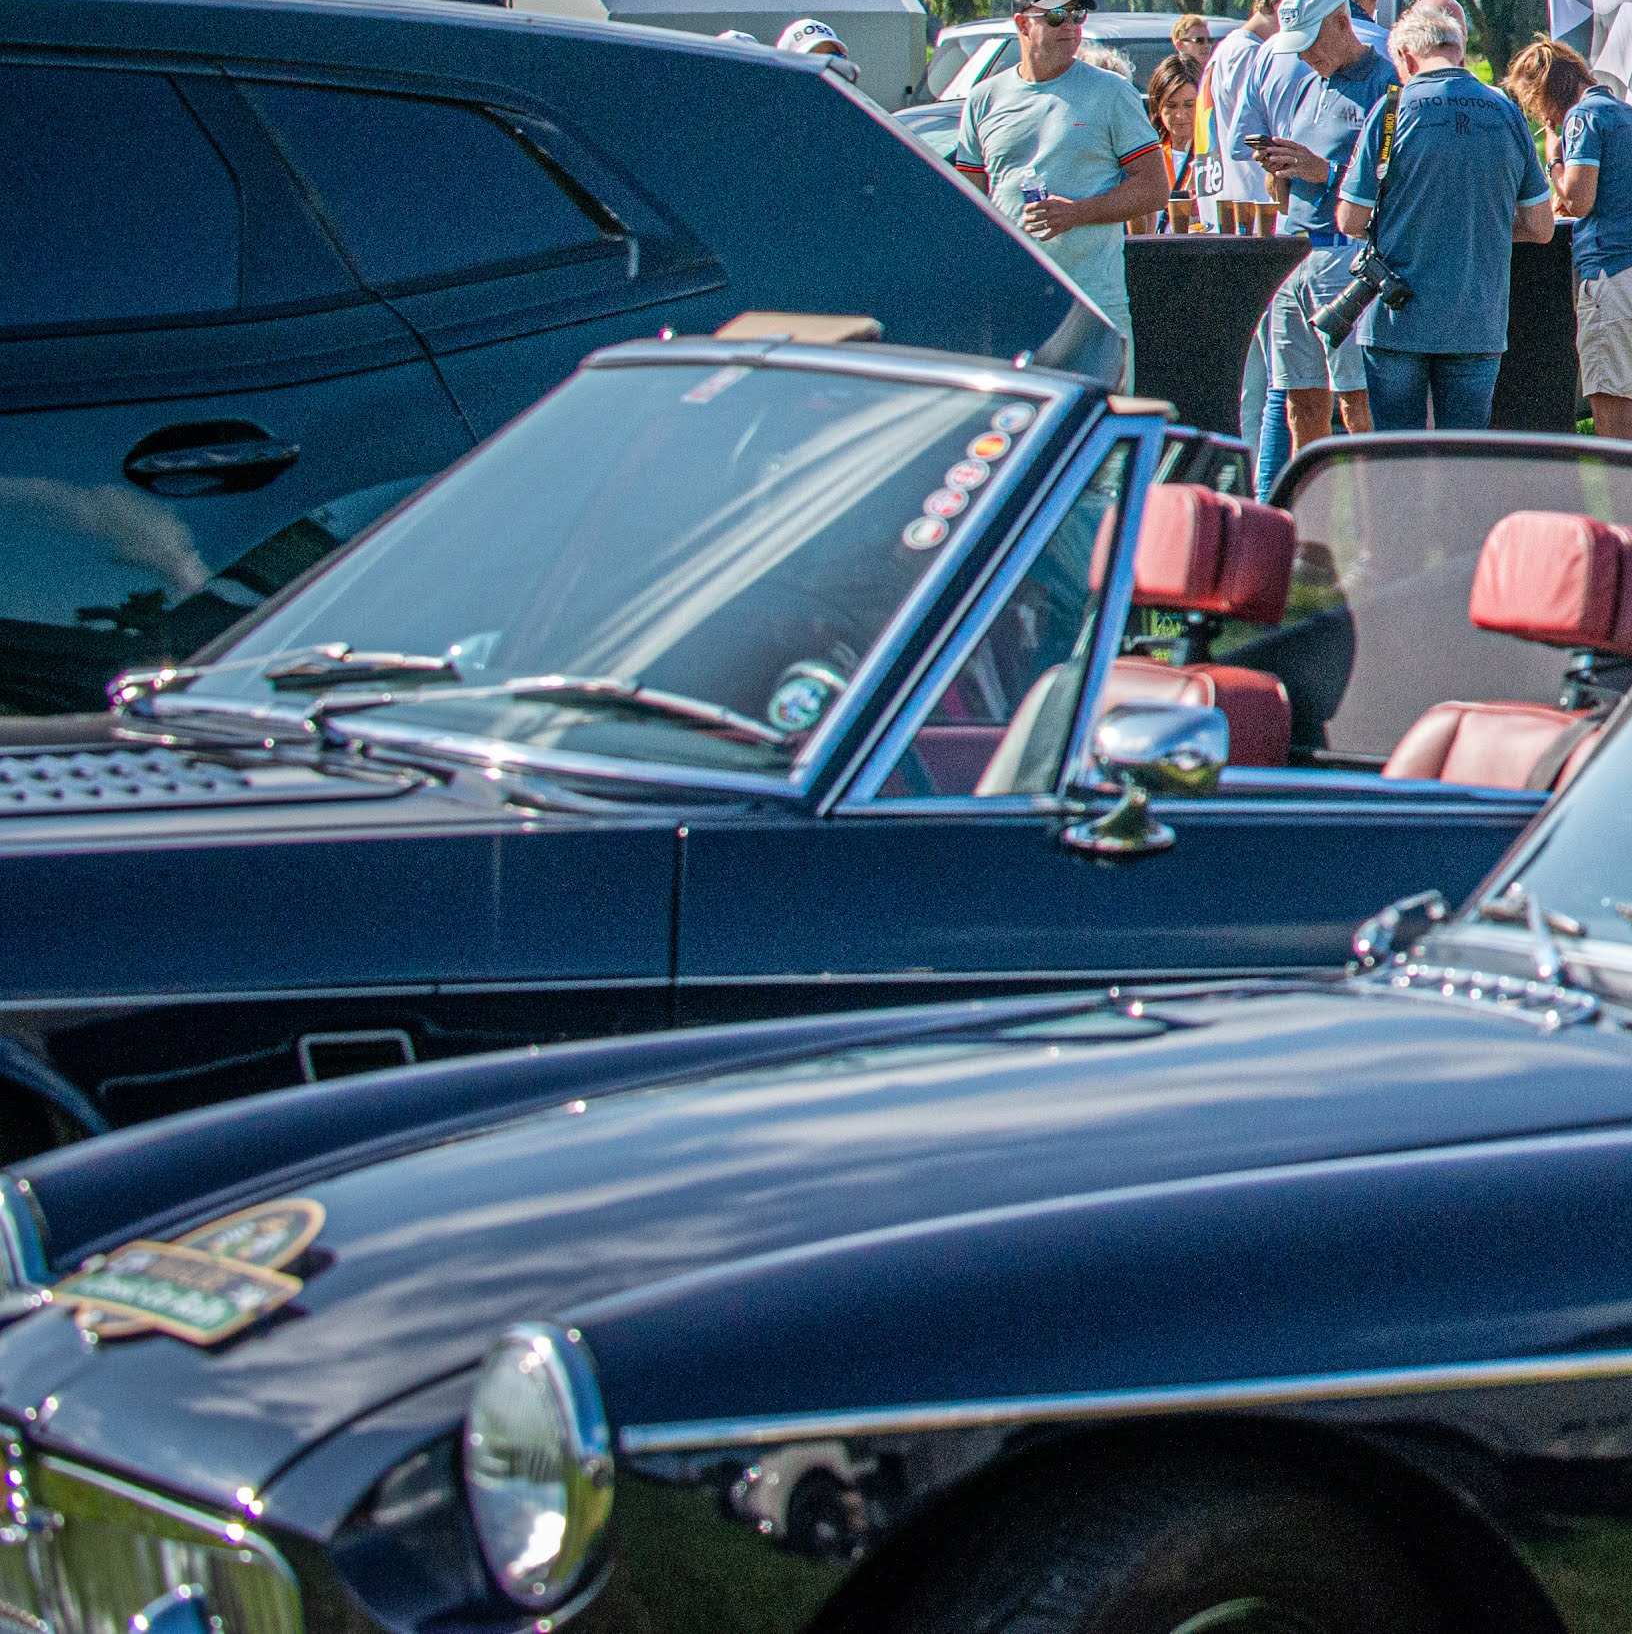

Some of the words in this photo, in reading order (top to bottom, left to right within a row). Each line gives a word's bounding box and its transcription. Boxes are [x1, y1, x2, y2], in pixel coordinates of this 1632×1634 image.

[794, 25, 833, 42] BOSS
[1448, 97, 1503, 111] MOTORS
[1382, 136, 1392, 160] Nikon
